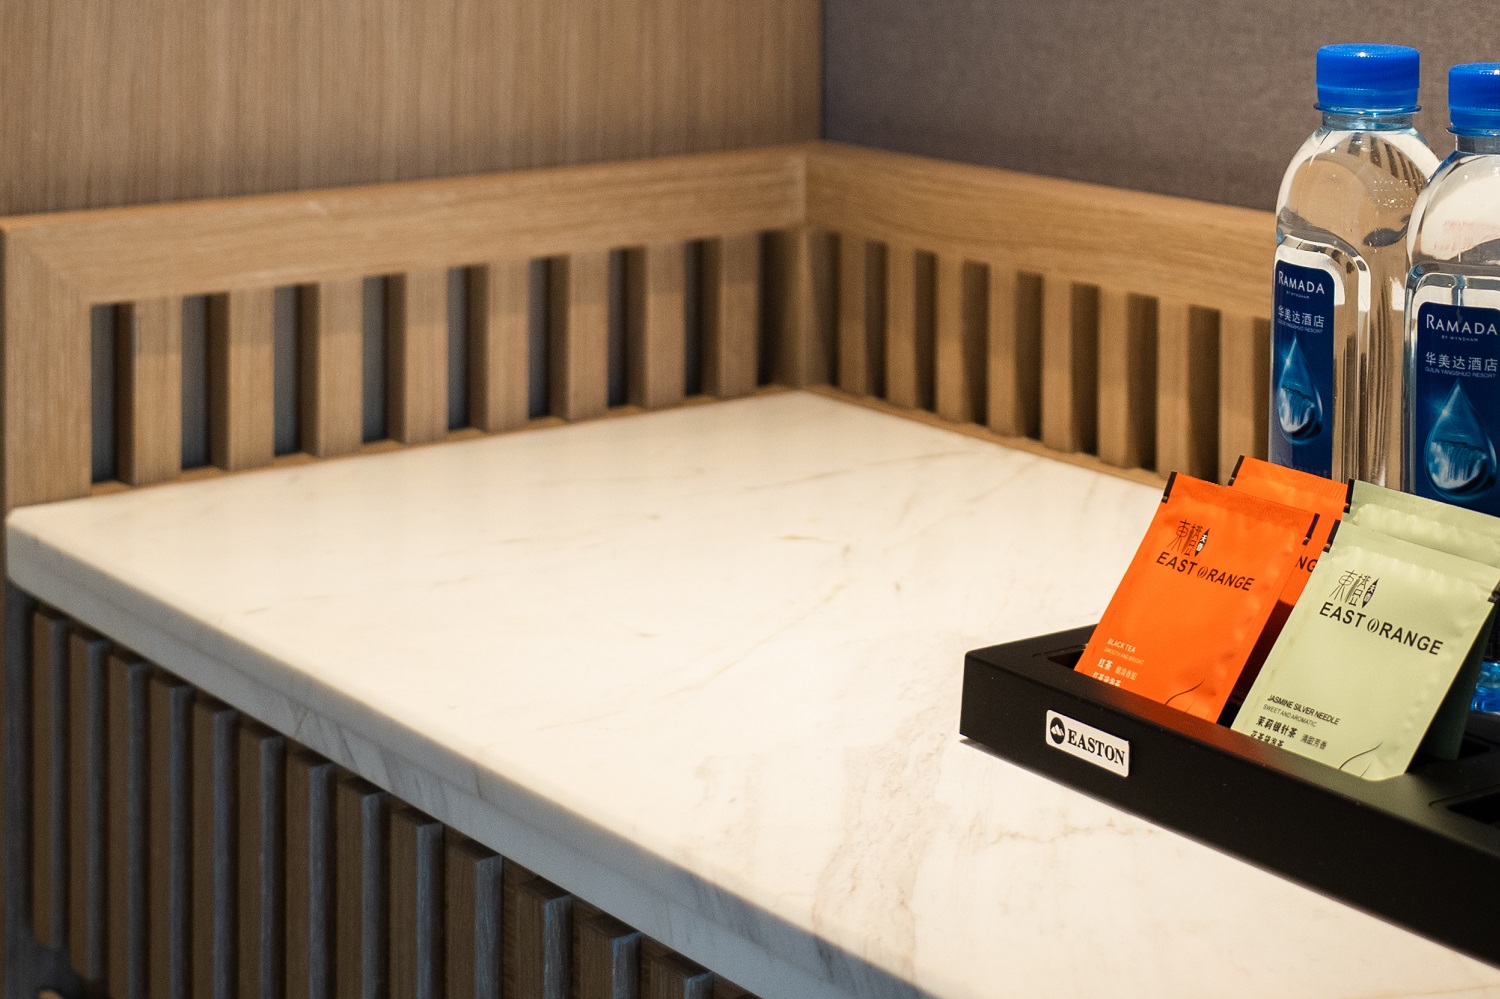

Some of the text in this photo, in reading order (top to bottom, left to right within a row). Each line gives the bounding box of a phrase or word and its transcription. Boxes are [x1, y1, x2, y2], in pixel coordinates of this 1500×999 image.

[1278, 270, 1325, 295] RAMADA
[1278, 305, 1325, 328] 华美达酒店
[1426, 313, 1498, 336] RAMADA
[1425, 351, 1498, 372] 华美达酒店
[1472, 371, 1497, 379] RESORT
[1156, 551, 1255, 592] EAST ORANGE
[1319, 601, 1444, 656] EAST ORANGE
[1107, 637, 1136, 653] BLACK TEA
[1097, 657, 1113, 671] 红茶
[1263, 703, 1318, 727] SWEET AND AROMATIC
[1267, 694, 1341, 726] JASMINE SILVER NEEDLE
[1255, 715, 1298, 738] 茉莉银针茶
[1067, 727, 1125, 767] EASTON
